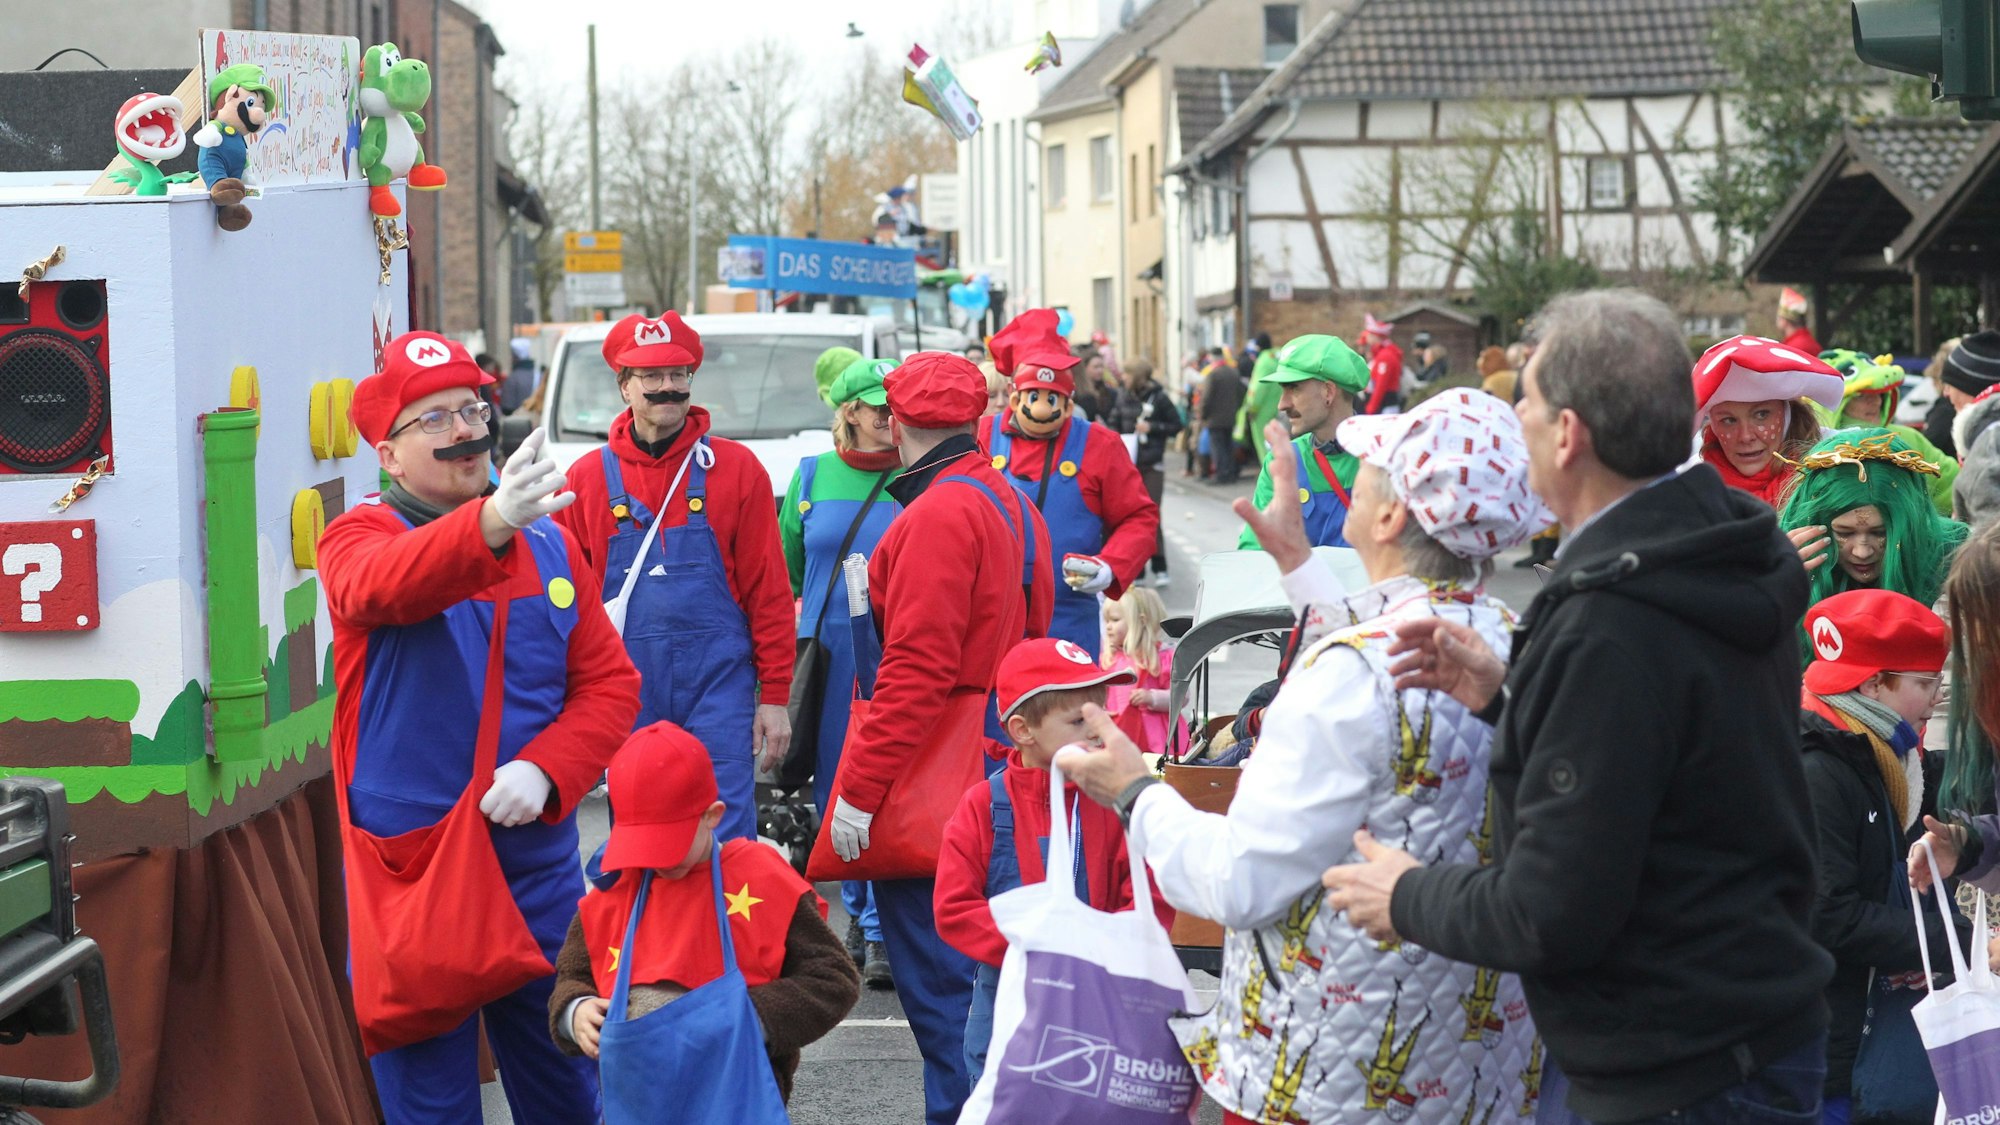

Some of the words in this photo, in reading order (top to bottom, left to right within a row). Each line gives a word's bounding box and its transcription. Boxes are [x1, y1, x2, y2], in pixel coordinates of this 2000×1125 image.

[778, 251, 821, 279] DAS
[640, 324, 665, 340] M
[417, 345, 445, 360] M
[1817, 625, 1840, 651] M
